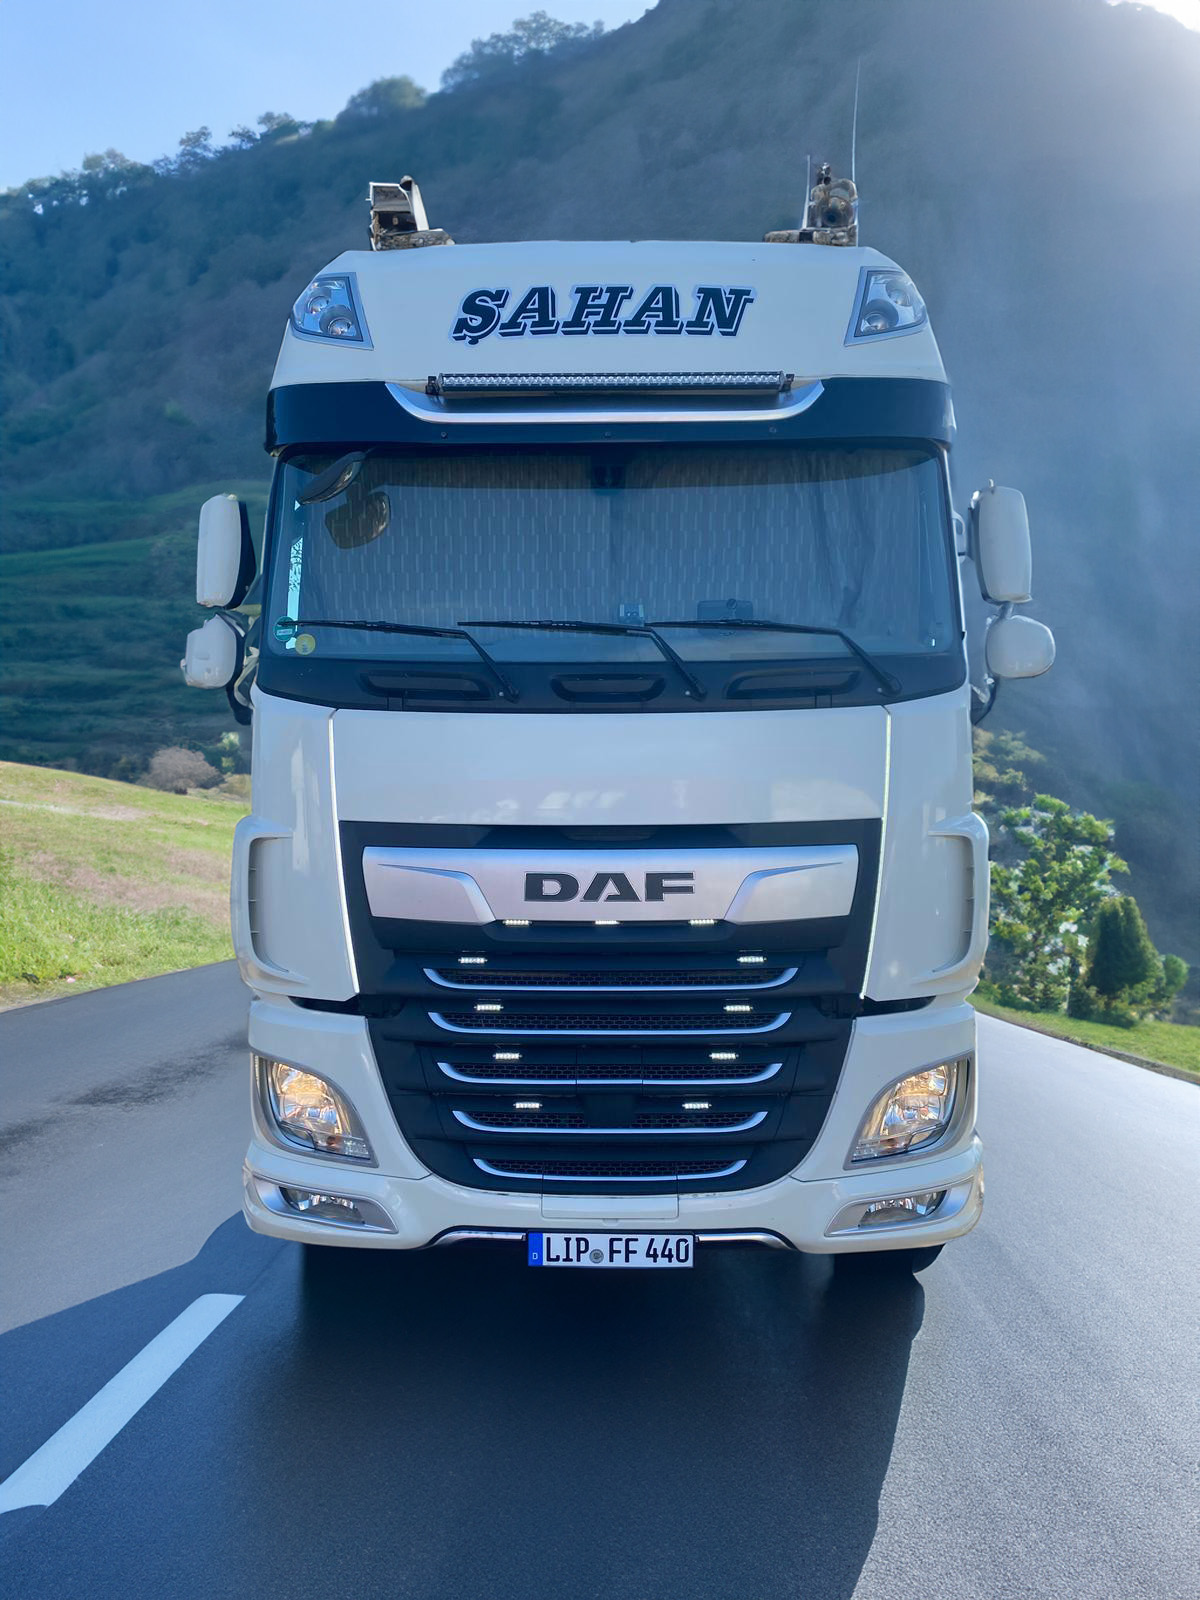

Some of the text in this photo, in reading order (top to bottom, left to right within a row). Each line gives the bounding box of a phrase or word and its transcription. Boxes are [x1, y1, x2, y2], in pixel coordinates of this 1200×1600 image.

[451, 285, 755, 346] ŞAHAN
[523, 872, 695, 902] DAF
[546, 1236, 690, 1264] LIP FF 440
